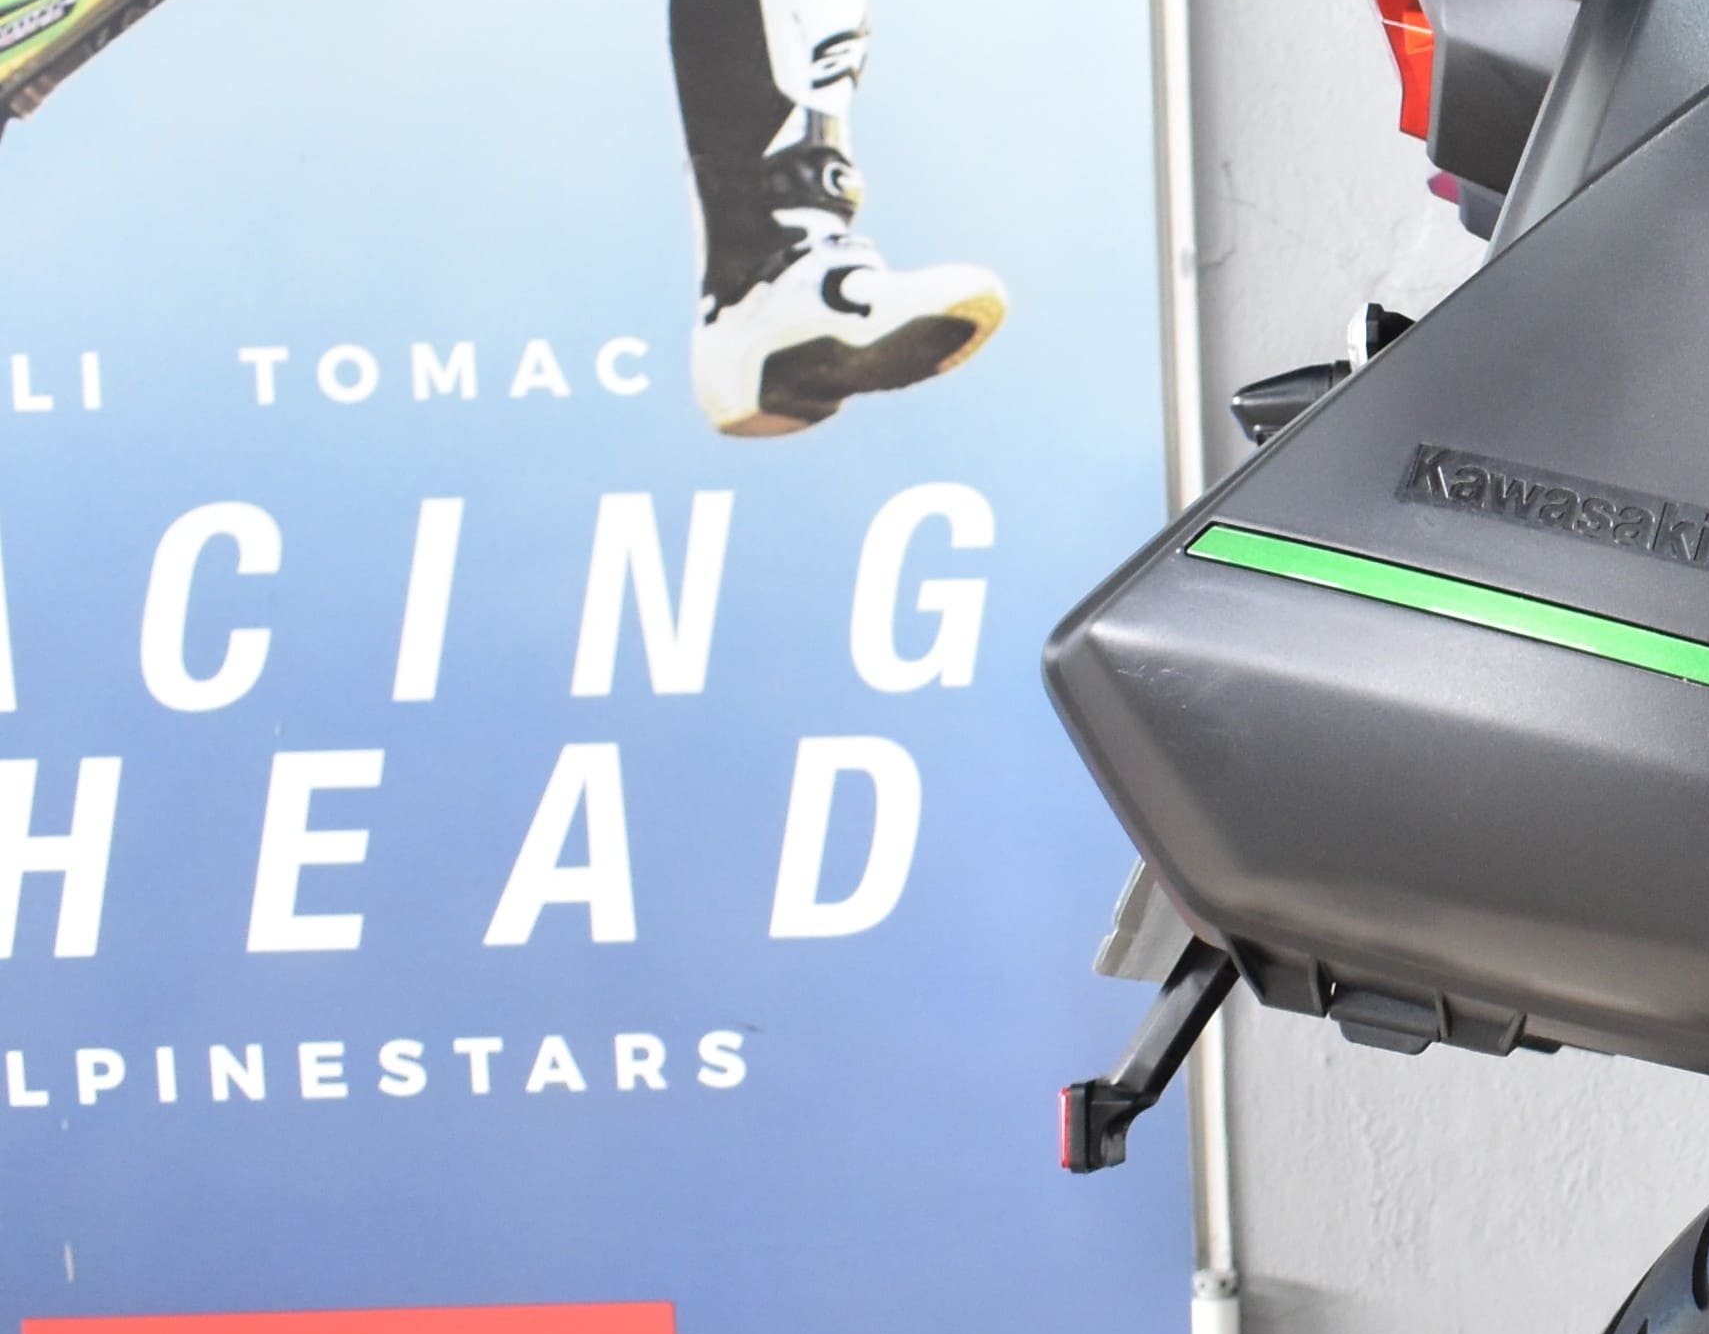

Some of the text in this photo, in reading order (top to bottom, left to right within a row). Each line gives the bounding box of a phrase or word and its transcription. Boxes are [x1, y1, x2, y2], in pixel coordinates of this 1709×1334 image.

[11, 336, 650, 413] LI TOMAC
[0, 482, 997, 713] CING
[0, 736, 922, 959] HEAD
[5, 1031, 748, 1107] LPINESTARS
